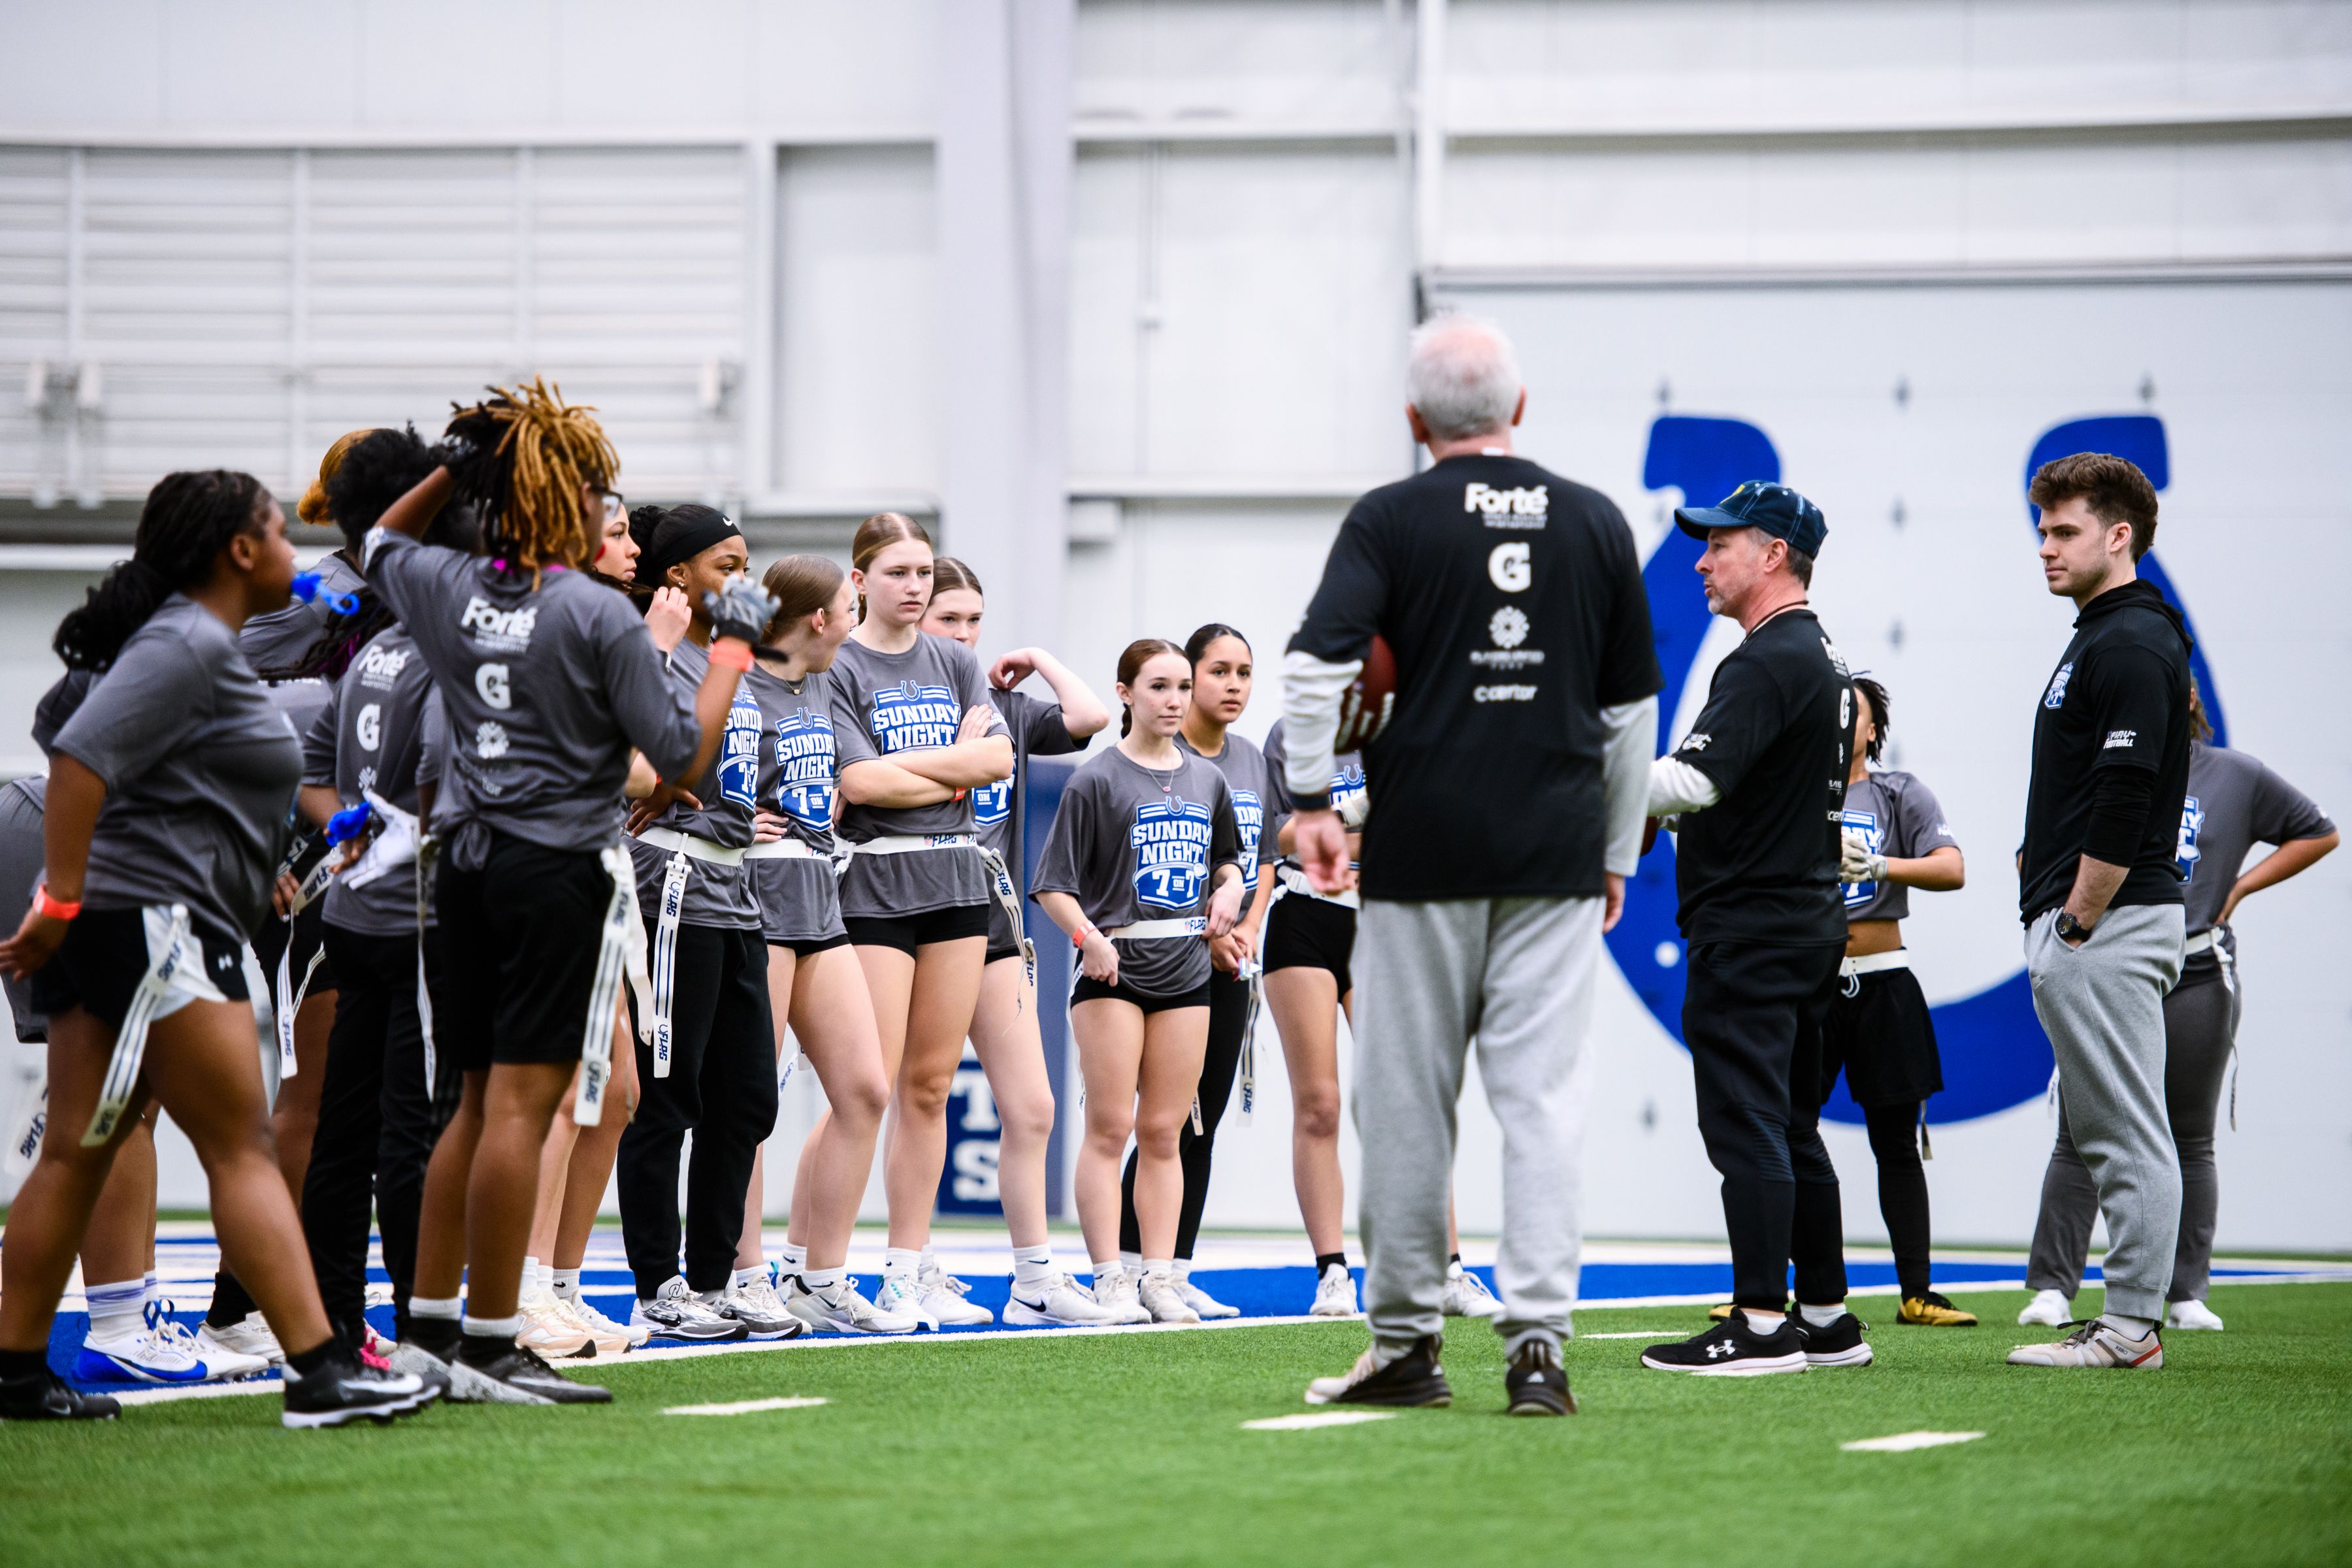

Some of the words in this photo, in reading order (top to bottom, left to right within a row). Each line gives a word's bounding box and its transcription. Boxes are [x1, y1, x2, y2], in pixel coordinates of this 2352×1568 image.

[1463, 482, 1549, 515] Forté
[1488, 542, 1531, 593] G
[461, 596, 538, 638] Forté
[357, 644, 411, 676] Forté
[475, 662, 512, 710] G
[873, 704, 960, 732] SUNDAY
[1840, 688, 1850, 729] G
[357, 703, 381, 751] G
[886, 723, 955, 751] NIGHT
[777, 734, 835, 762] SUNDA
[2103, 738, 2134, 749] FOOTBALL
[739, 762, 749, 794] 7
[792, 786, 809, 816] 7
[810, 797, 824, 806] ON
[977, 792, 990, 802] ON
[991, 781, 1007, 811] 7
[1132, 820, 1211, 846] SUNDAY
[1141, 840, 1203, 865] NIGHT
[997, 871, 1012, 896] FLAG
[1152, 869, 1171, 898] 7
[1173, 879, 1184, 888] ON
[1185, 870, 1195, 898] 7
[666, 889, 680, 917] FLAG
[1190, 919, 1206, 933] FLAG
[282, 1023, 293, 1057] FLAG
[659, 1031, 668, 1062] FLAG
[1243, 1086, 1252, 1113] FLAG
